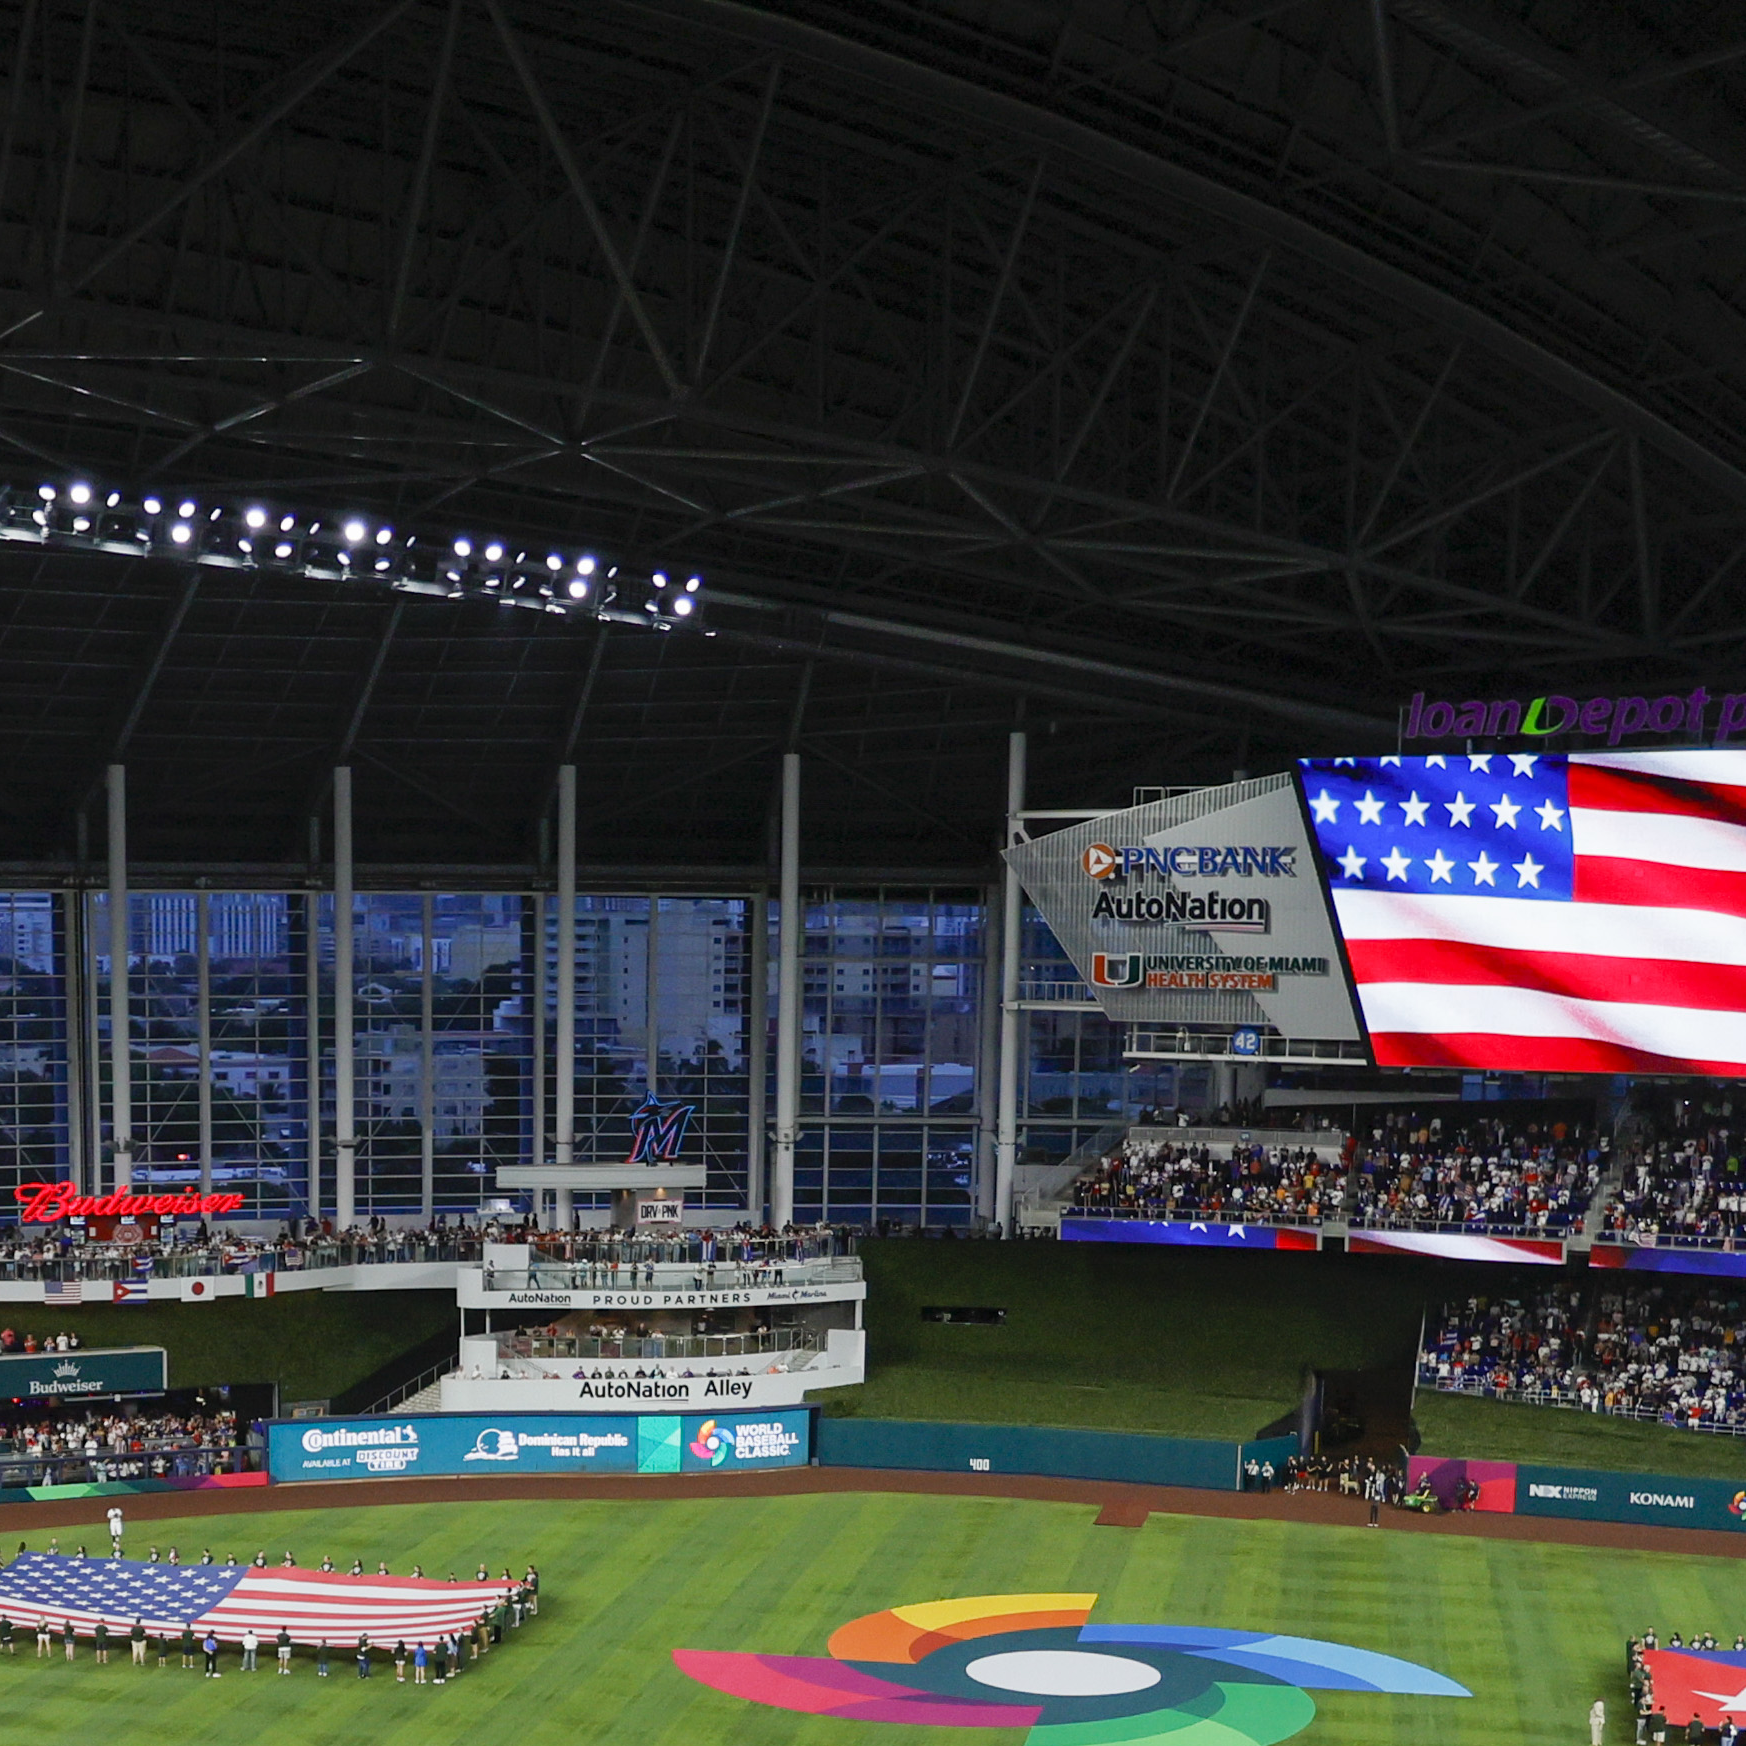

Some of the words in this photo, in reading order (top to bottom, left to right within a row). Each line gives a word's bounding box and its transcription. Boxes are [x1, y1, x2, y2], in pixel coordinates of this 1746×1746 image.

[1405, 686, 1711, 746] loanDepot
[1092, 890, 1265, 922] AutoNation
[1146, 957, 1243, 971] UNIVERSITY
[1244, 957, 1266, 972] OF
[1268, 957, 1326, 973] MIAMI
[1146, 973, 1206, 988] HEALTH
[1208, 973, 1274, 989] SYSTEM
[1234, 1034, 1256, 1051] 42
[14, 1180, 245, 1222] Budweiser
[508, 1293, 571, 1304] AutoNation
[593, 1295, 653, 1305] PROUD
[664, 1293, 751, 1305] PARTNERS
[767, 1291, 791, 1300] Miami
[800, 1290, 827, 1299] Marlins
[29, 1378, 104, 1395] Budweiser
[579, 1381, 689, 1398] AutoNation
[704, 1380, 753, 1400] Alley
[735, 1423, 783, 1436] WORLD
[302, 1428, 402, 1453] Continental
[518, 1434, 577, 1447] Dominican
[580, 1433, 628, 1447] Republic
[735, 1433, 799, 1447] BASEBALL
[357, 1449, 418, 1462] DISCOUNT
[551, 1446, 569, 1457] Has
[572, 1446, 579, 1457] it
[302, 1459, 341, 1468] AVAILABLE
[342, 1458, 351, 1467] AT
[370, 1460, 404, 1471] TIRE
[969, 1458, 990, 1471] 400
[1563, 1486, 1597, 1495] NIPPON
[1563, 1493, 1597, 1502] EXPRESS
[1630, 1492, 1694, 1509] KONAMI
